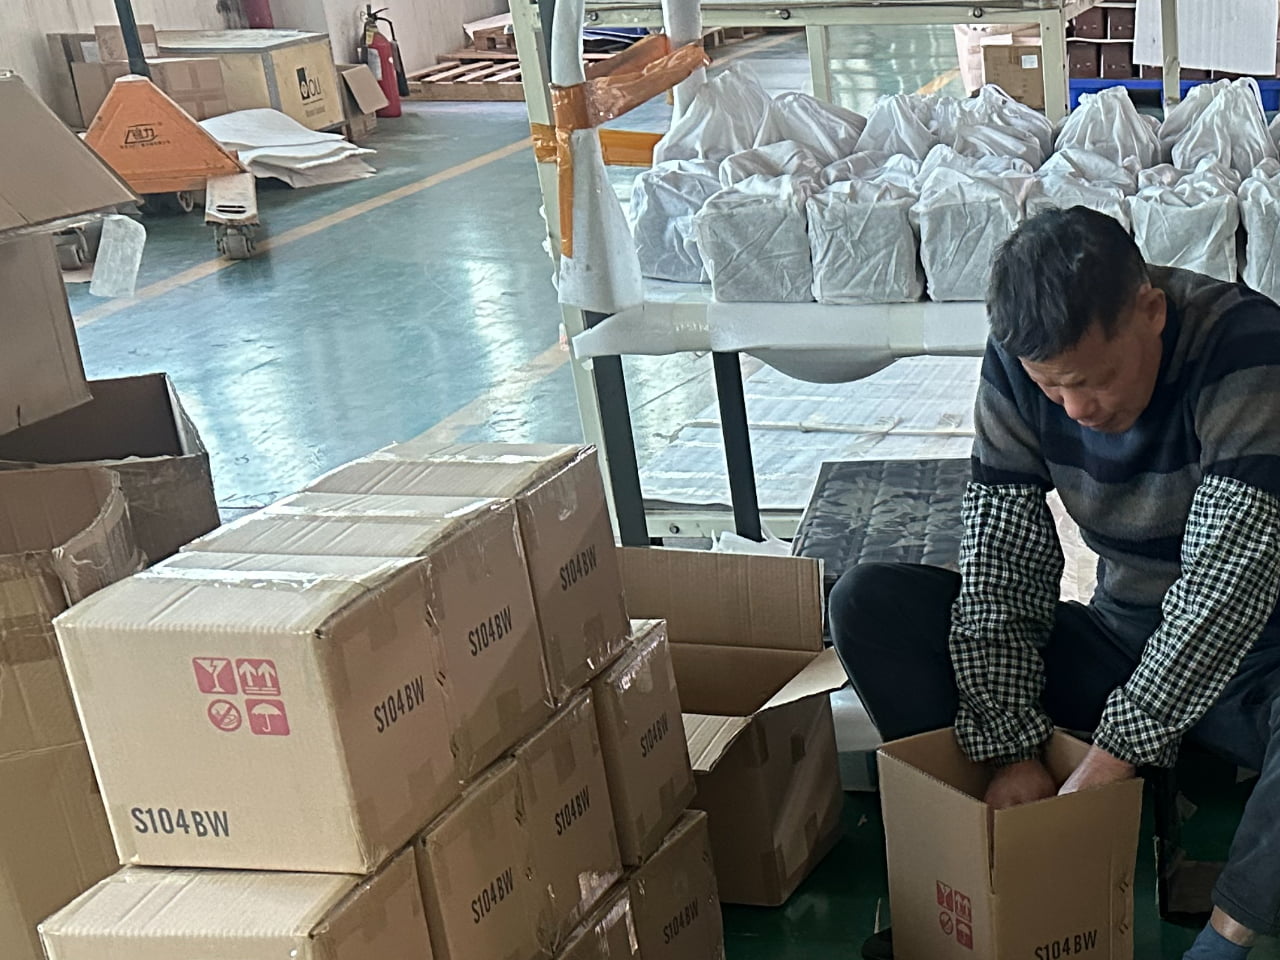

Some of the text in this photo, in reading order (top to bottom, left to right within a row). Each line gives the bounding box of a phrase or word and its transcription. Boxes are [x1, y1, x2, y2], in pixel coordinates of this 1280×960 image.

[560, 544, 596, 591] S104BW
[469, 606, 512, 656] S104BW
[374, 676, 424, 733] S104BW
[641, 713, 668, 757] S104BW
[131, 808, 229, 837] S104BW
[555, 786, 589, 836] S104BW
[472, 868, 513, 924] S104BW
[663, 898, 698, 944] S104BW
